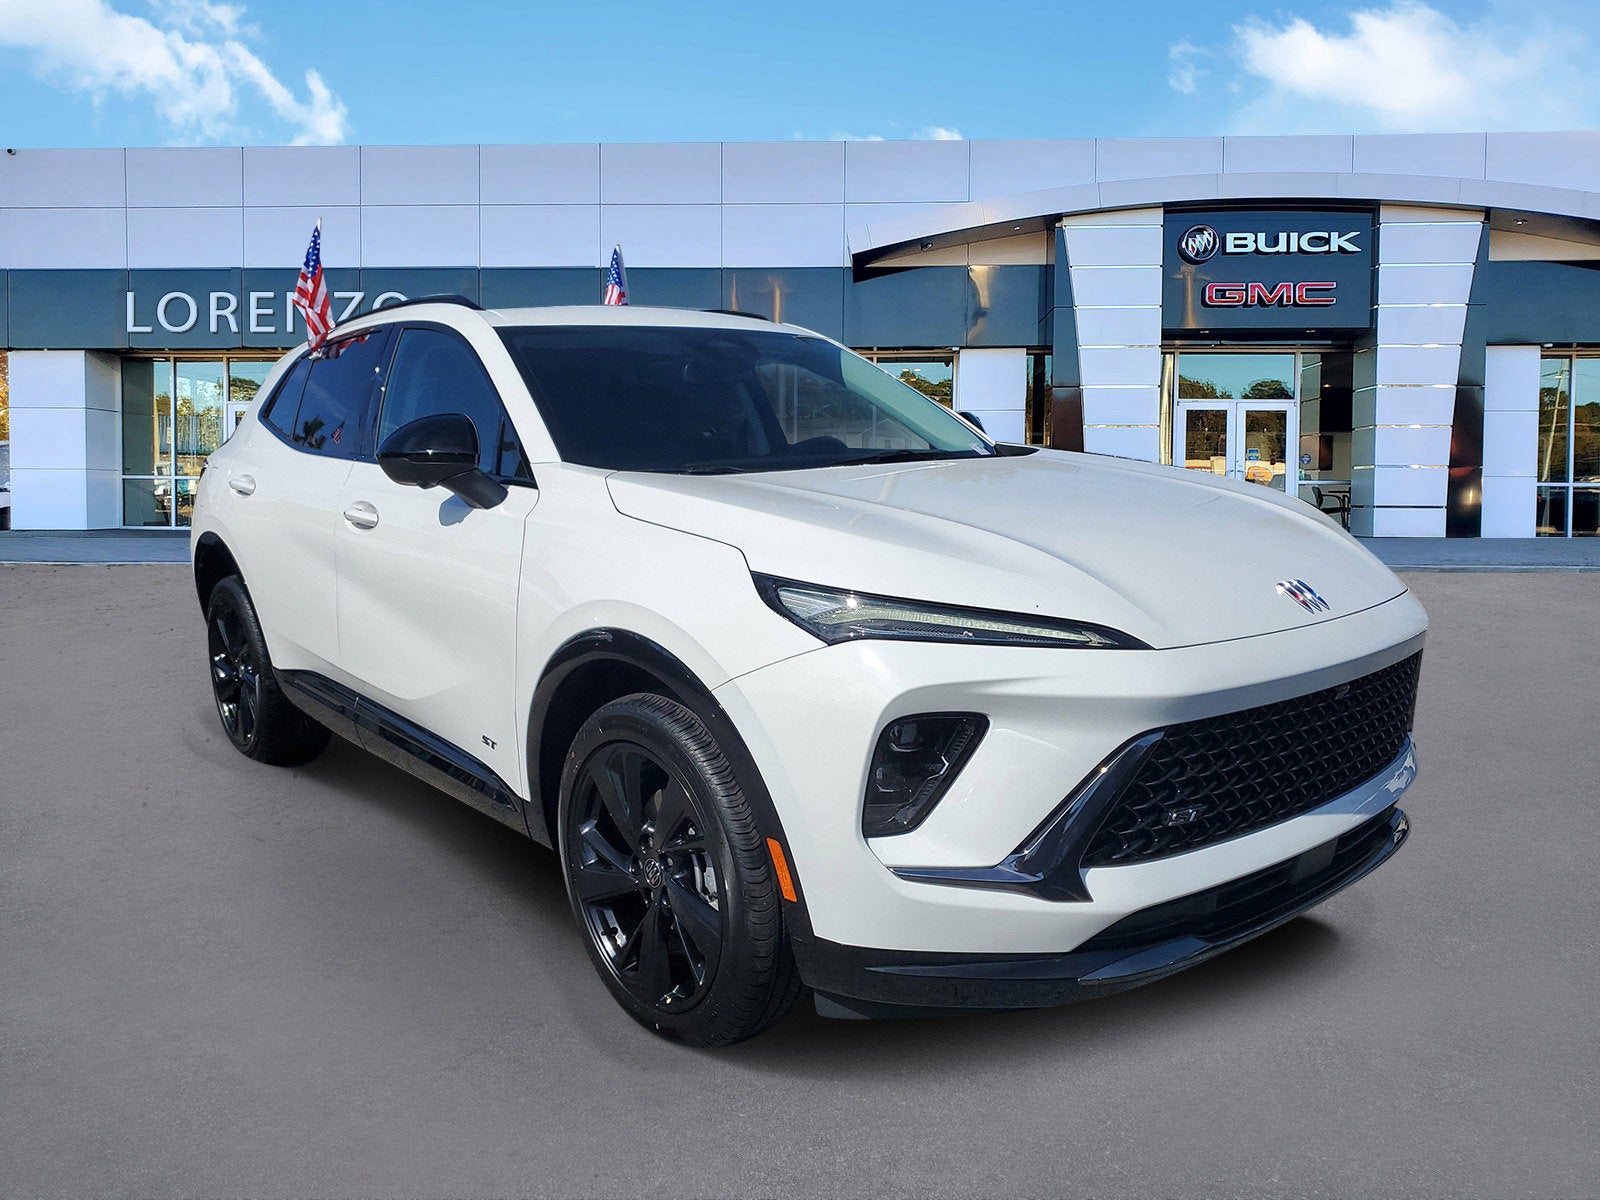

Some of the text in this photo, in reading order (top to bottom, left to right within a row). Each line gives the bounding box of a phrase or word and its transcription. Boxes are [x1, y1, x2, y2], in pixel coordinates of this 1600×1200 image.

[1225, 231, 1362, 254] BUICK
[1206, 281, 1337, 305] GMC
[481, 734, 498, 750] ST
